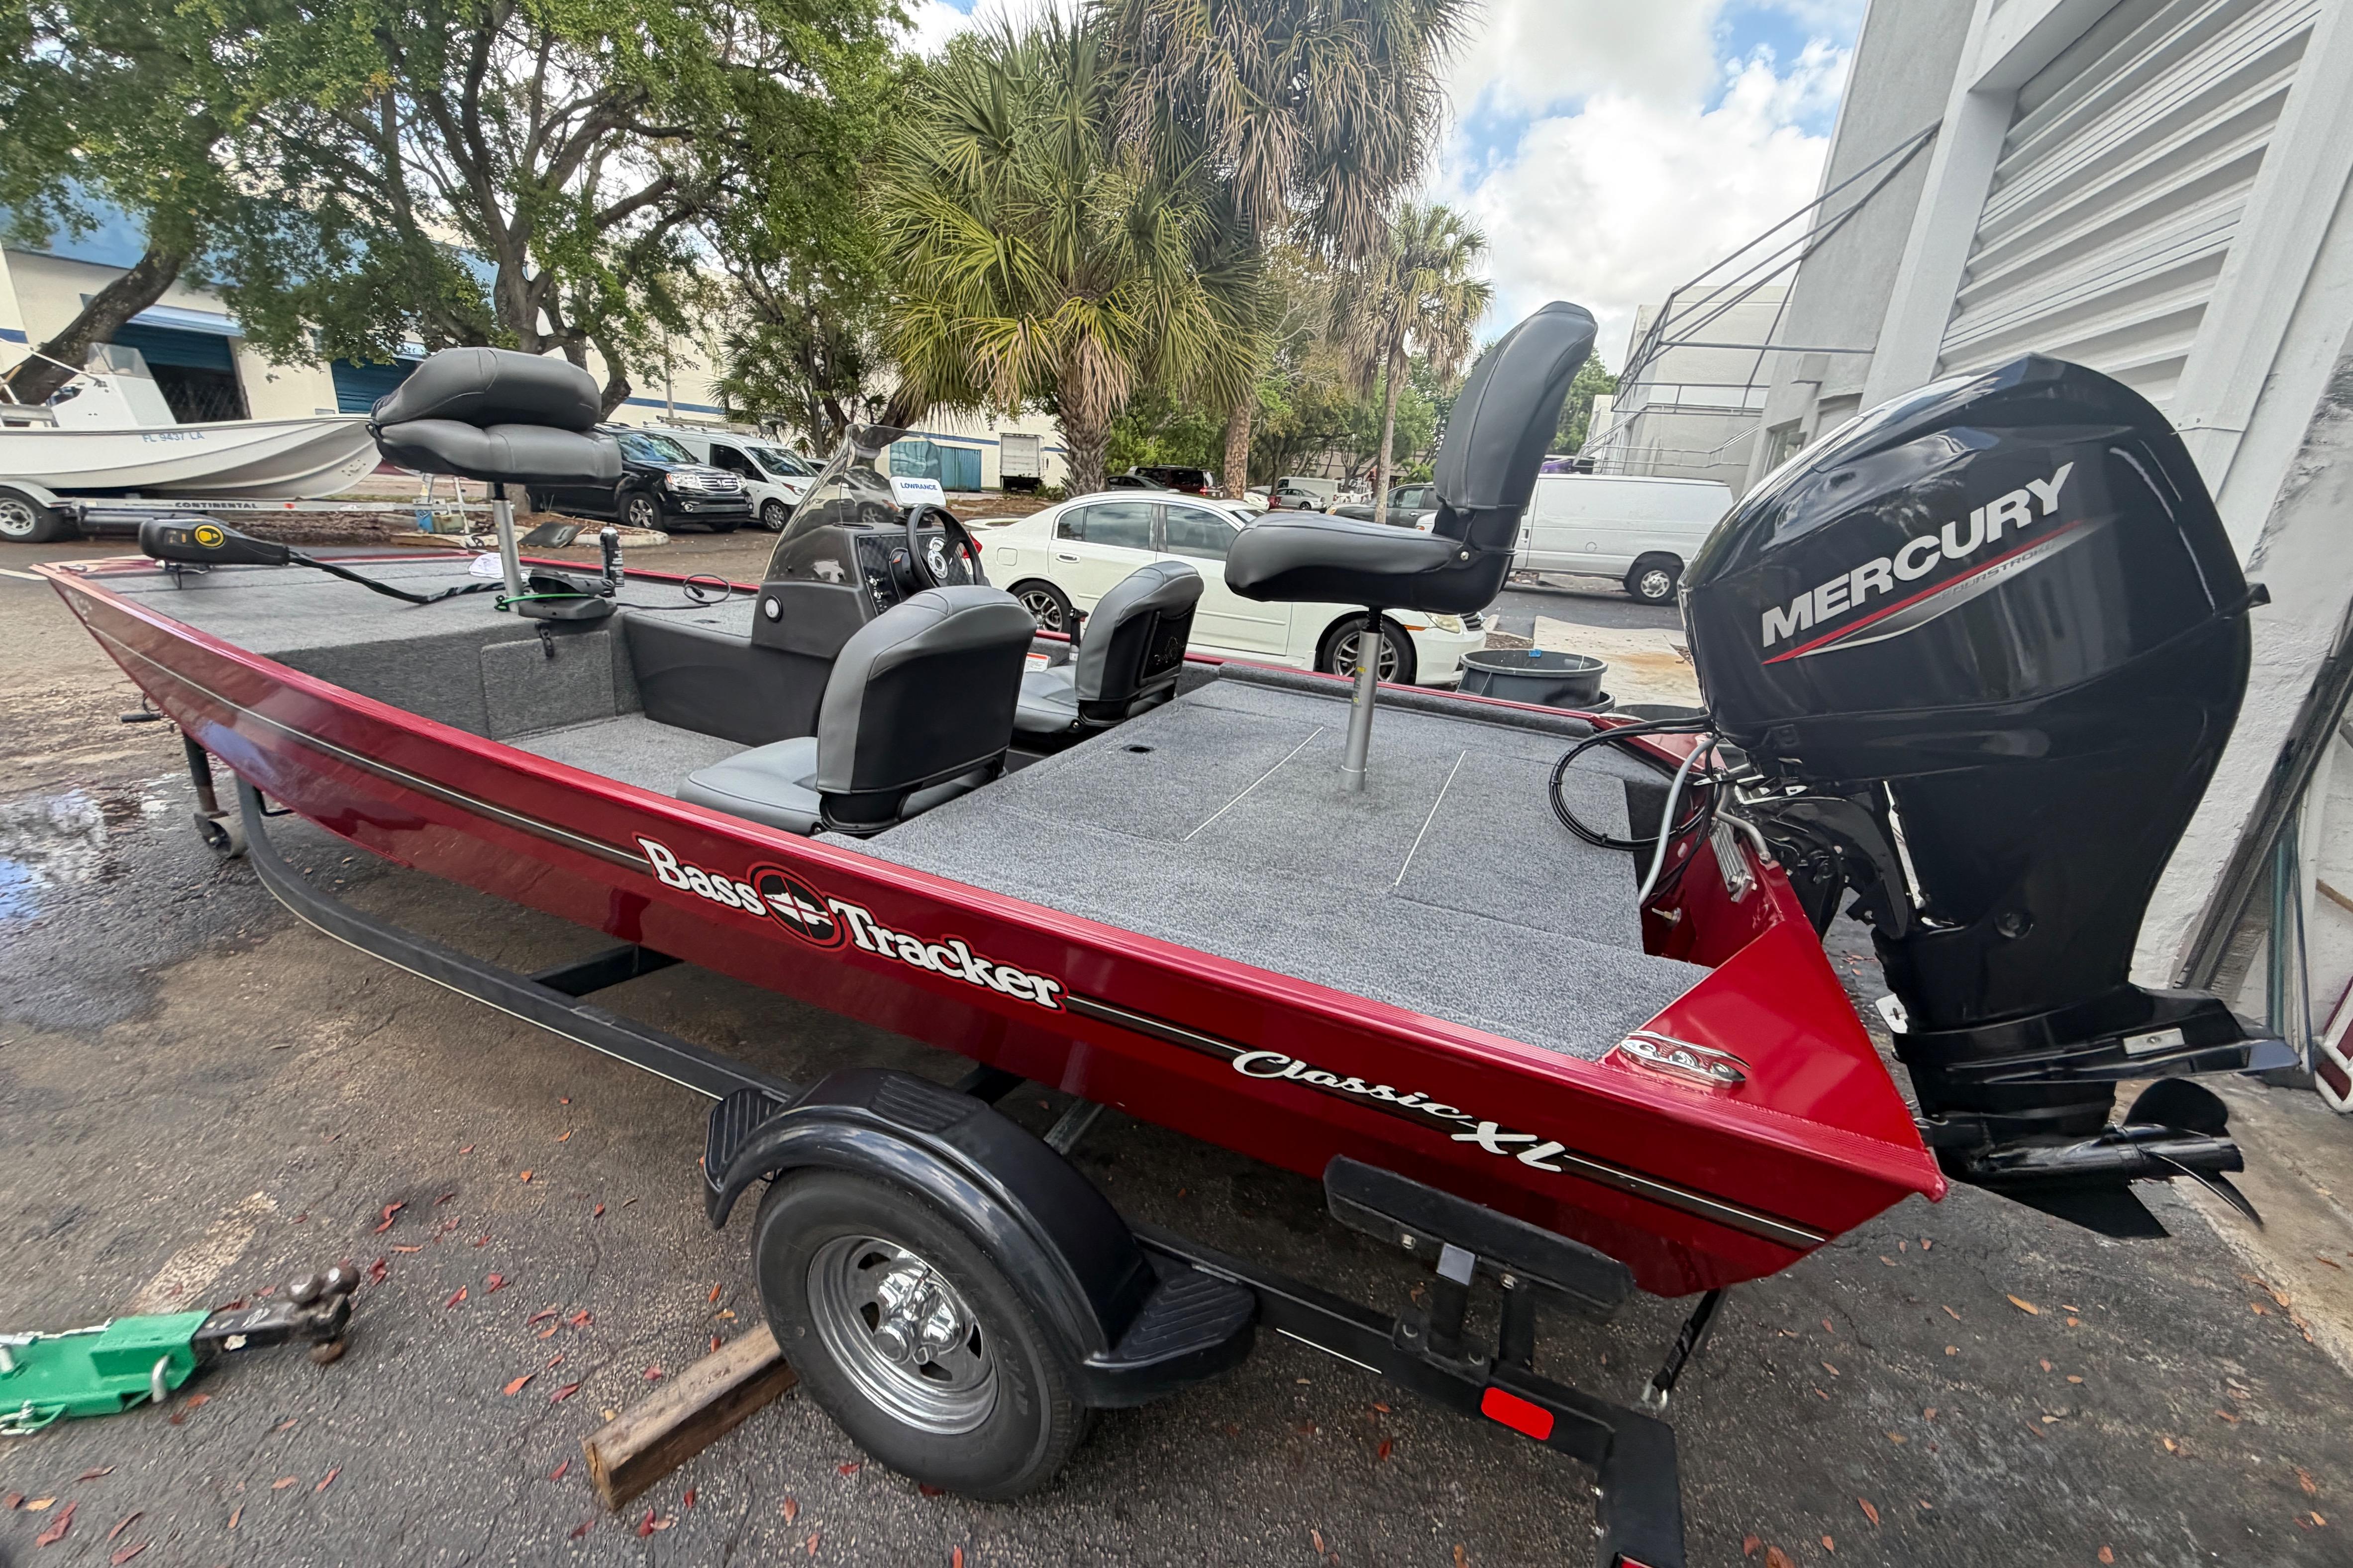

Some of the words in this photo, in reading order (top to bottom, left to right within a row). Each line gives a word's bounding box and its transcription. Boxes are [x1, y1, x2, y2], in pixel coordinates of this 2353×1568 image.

[142, 433, 157, 442] FL
[189, 431, 205, 439] LA
[175, 499, 258, 508] CONTINENTAL
[1762, 462, 2074, 648] MERCURY
[637, 837, 766, 916] Bass
[827, 898, 1060, 1008] Tracker
[1232, 1051, 1473, 1119] Classic
[1451, 1121, 1565, 1172] XL
